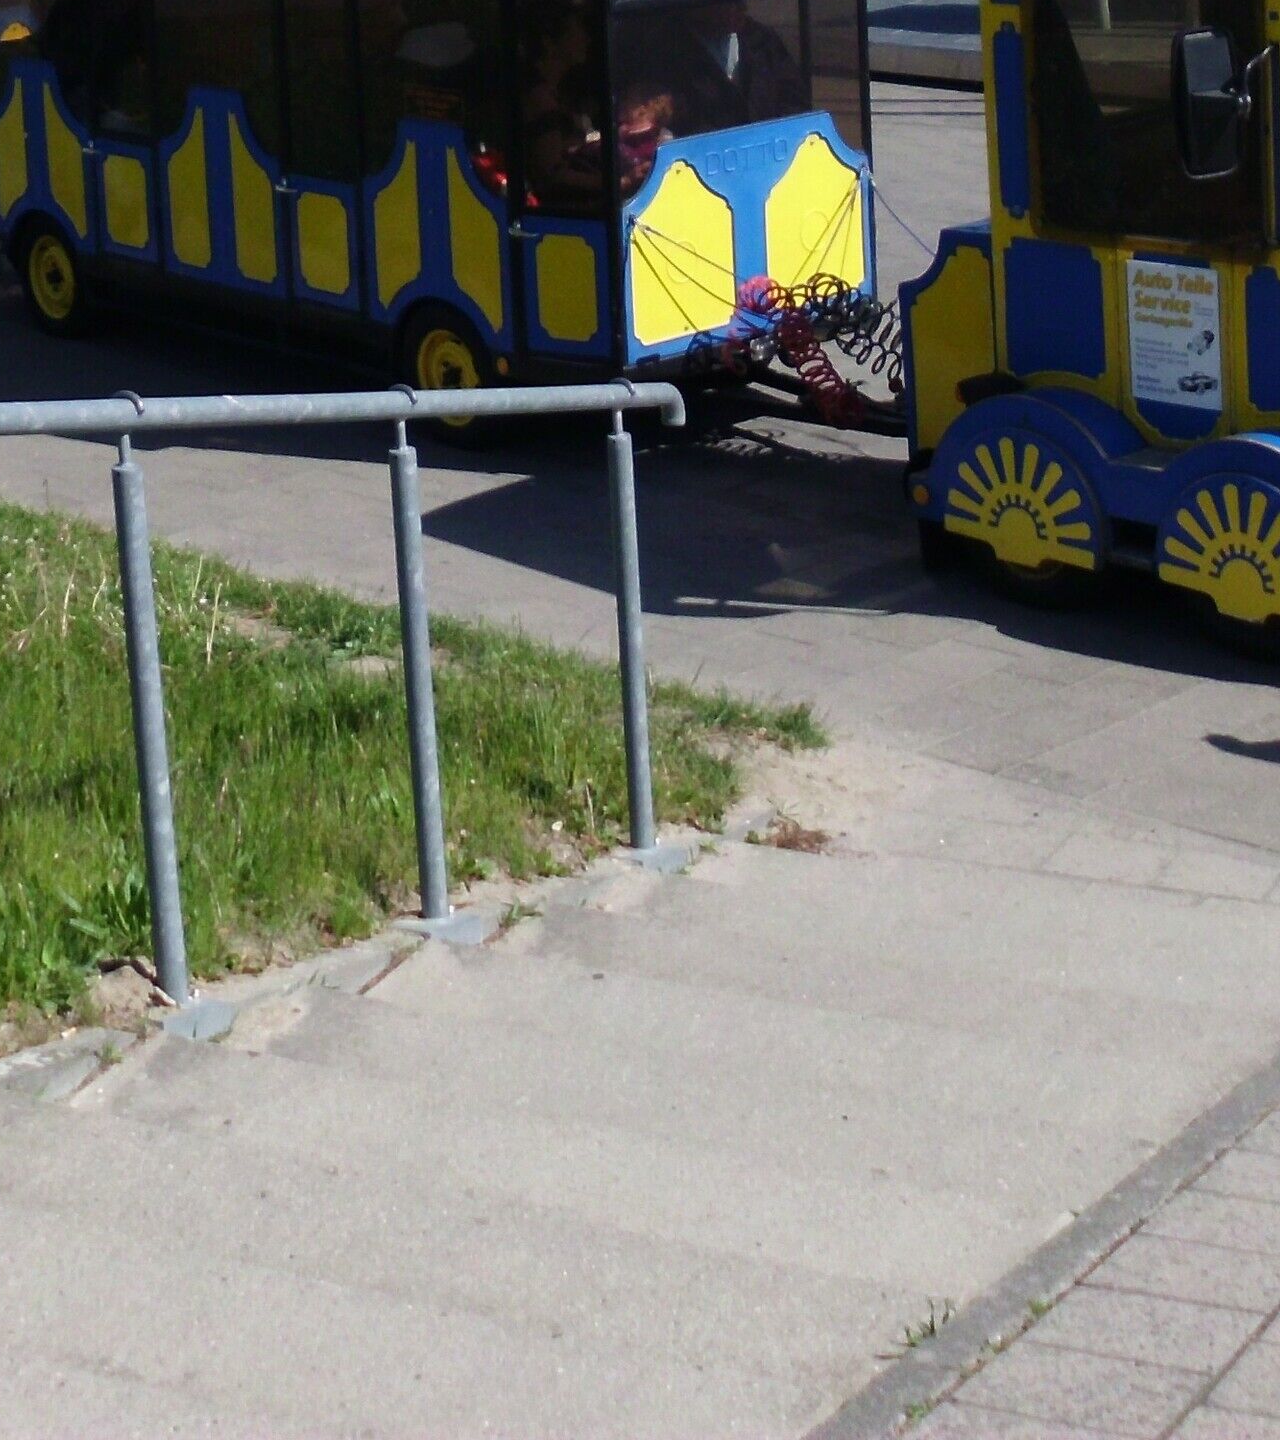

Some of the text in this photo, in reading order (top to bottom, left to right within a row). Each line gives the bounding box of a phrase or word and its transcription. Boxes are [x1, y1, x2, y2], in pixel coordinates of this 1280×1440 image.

[705, 138, 787, 176] DOTTO
[1133, 268, 1214, 295] Auto Teile
[1133, 289, 1192, 314] Service
